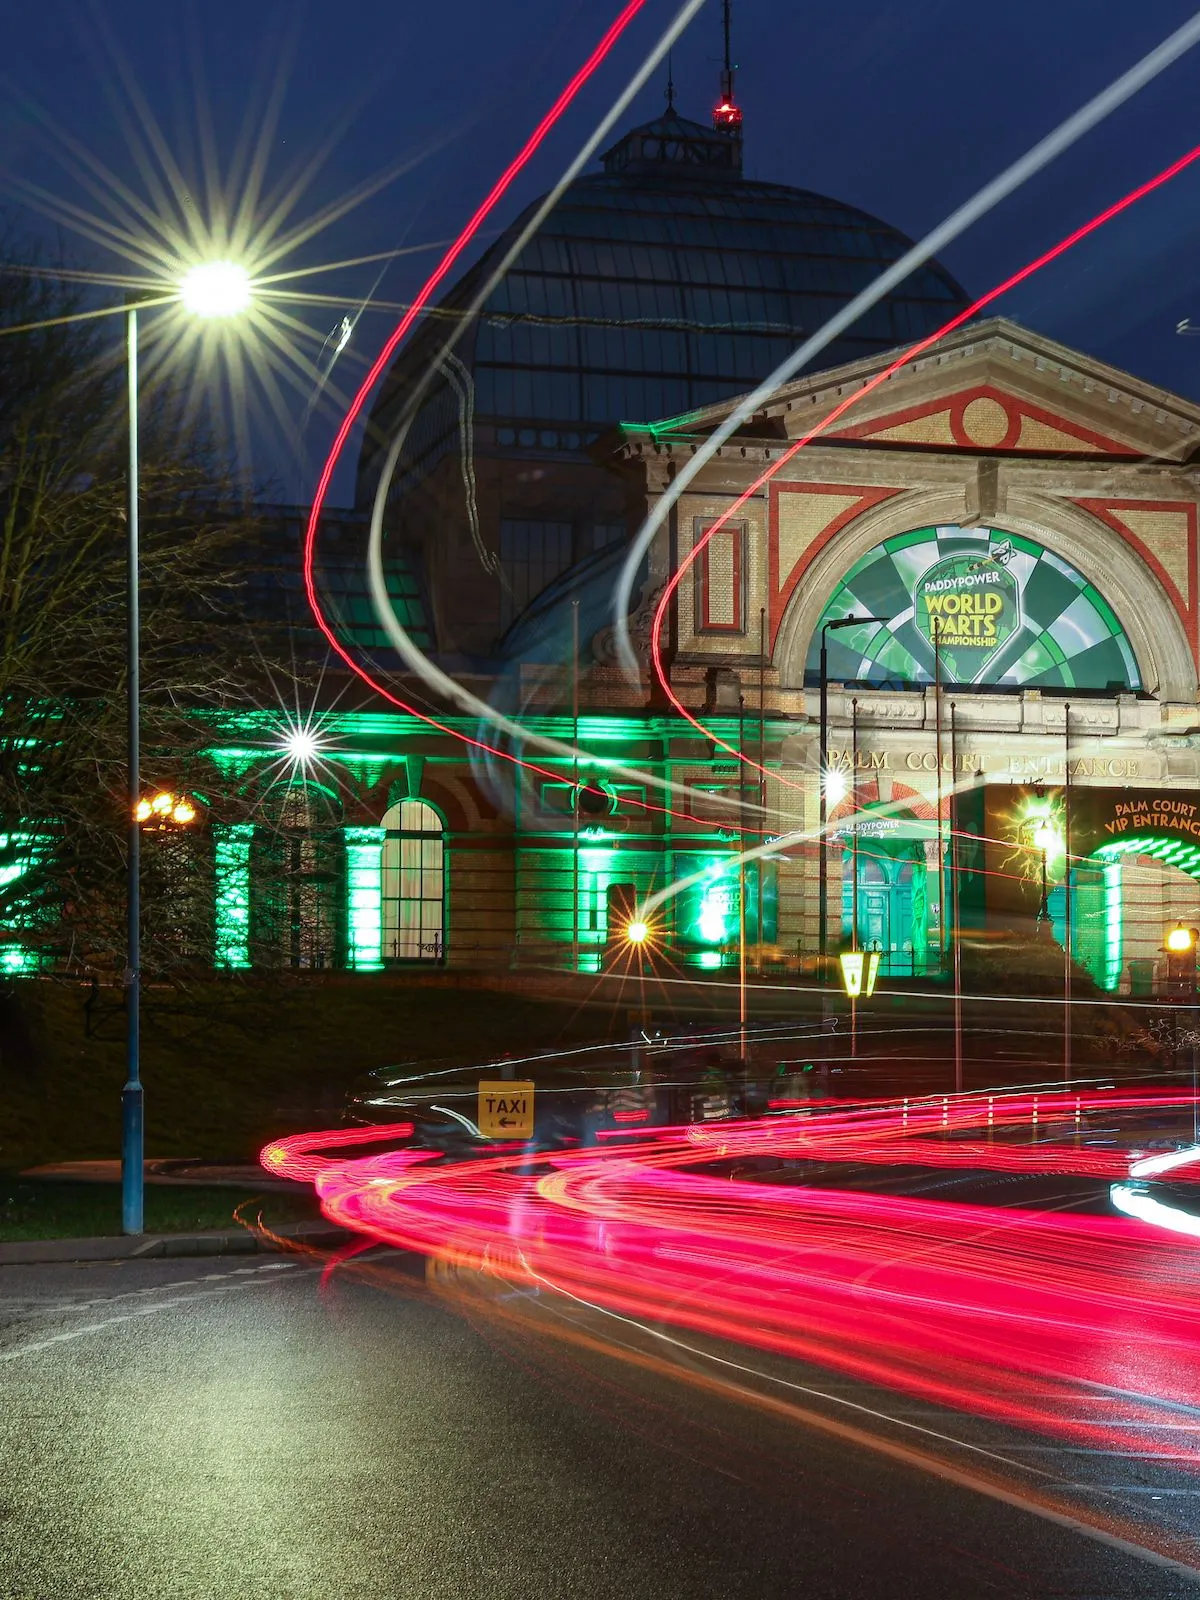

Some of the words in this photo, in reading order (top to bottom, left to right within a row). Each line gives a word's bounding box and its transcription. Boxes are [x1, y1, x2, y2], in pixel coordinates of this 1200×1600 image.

[924, 571, 1001, 593] PADDYPOWER
[924, 592, 1003, 614] WORLD
[929, 614, 997, 636] DARTS
[929, 635, 997, 647] CHAMPIONSHIP
[826, 749, 890, 769] PALM
[905, 751, 991, 773] COURT
[1007, 754, 1140, 777] ENTRANCE
[1115, 800, 1148, 816] PALM
[1152, 799, 1197, 817] COURT
[1104, 817, 1129, 834] VIP
[485, 1099, 527, 1114] TAXI
